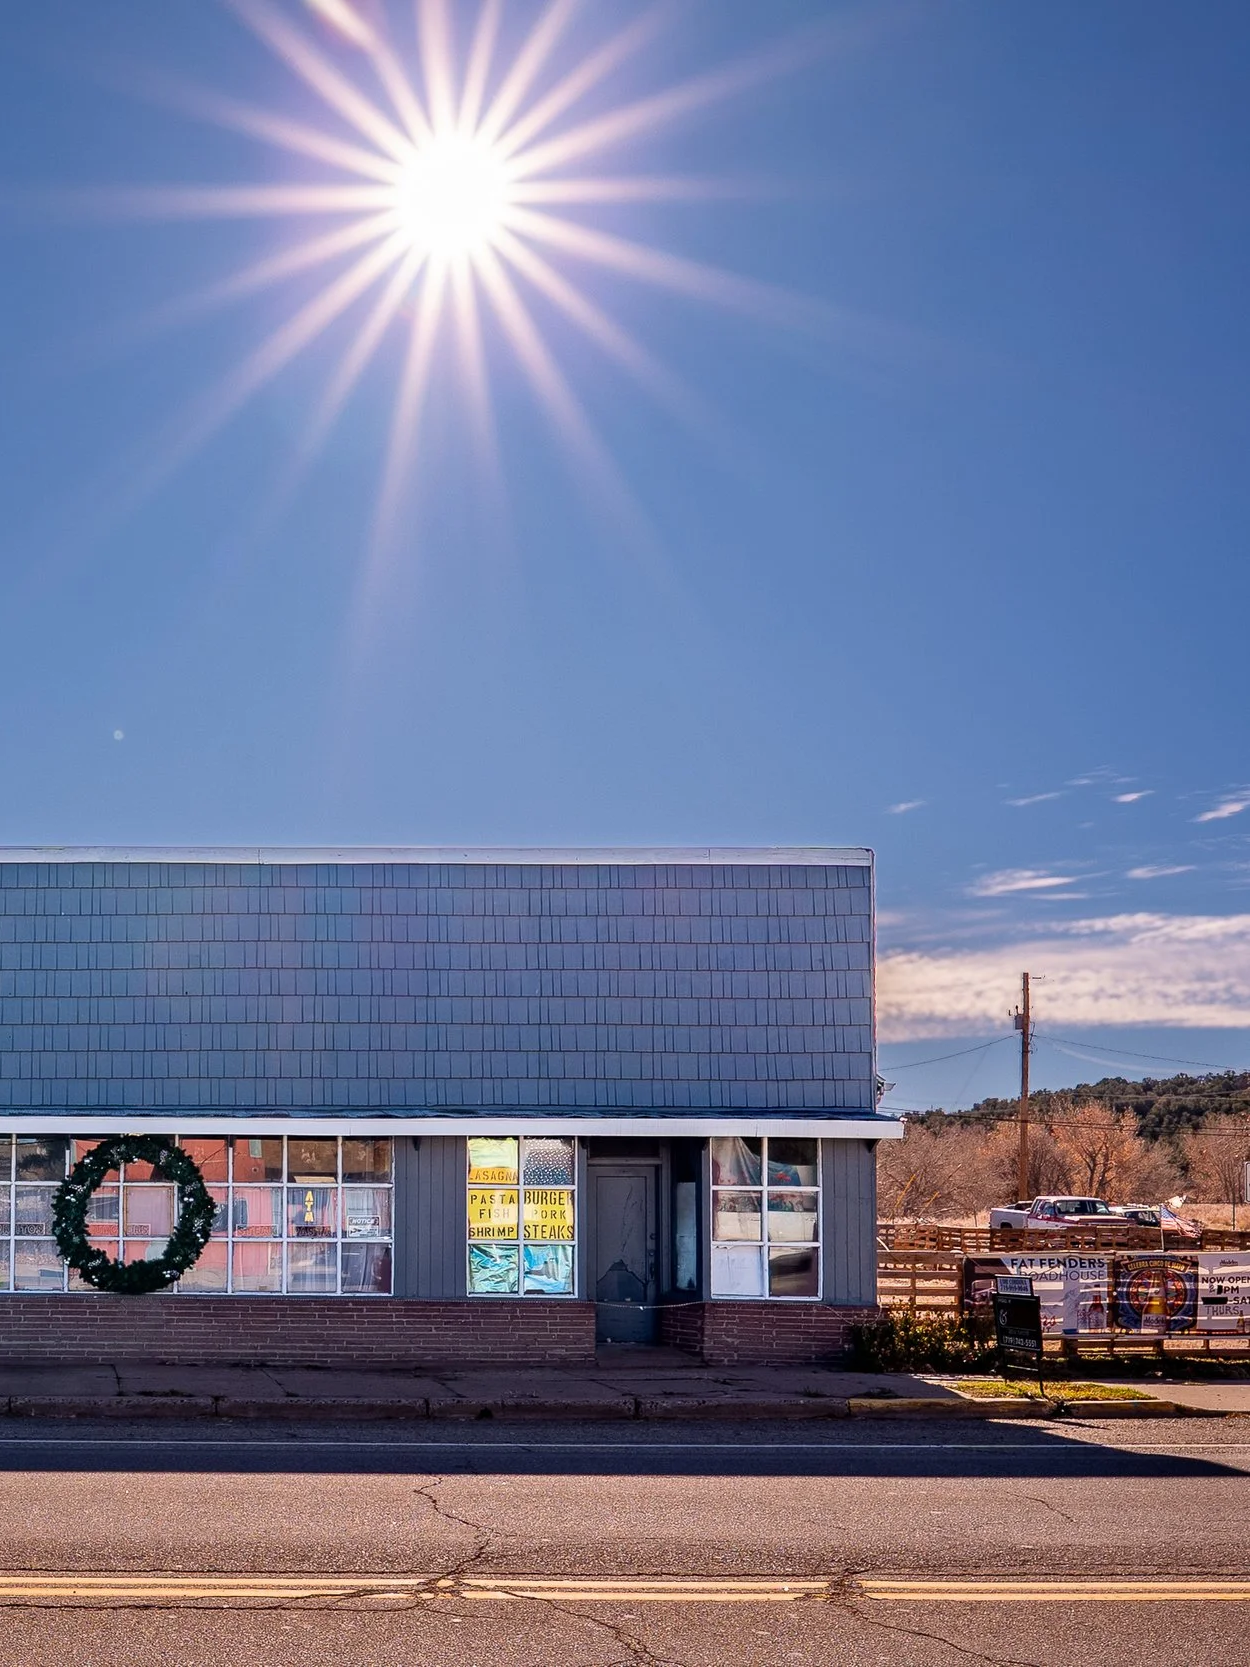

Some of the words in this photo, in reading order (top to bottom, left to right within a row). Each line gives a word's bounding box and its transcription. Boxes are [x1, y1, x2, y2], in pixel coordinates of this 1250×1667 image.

[470, 1194, 516, 1205] PASTA
[479, 1208, 510, 1219] FISH
[531, 1208, 567, 1220] PORK
[469, 1226, 515, 1238] SHRIMP
[523, 1224, 574, 1239] STEAKS
[1011, 1258, 1035, 1268] FAT
[1039, 1258, 1105, 1268] FENDERS
[1202, 1276, 1225, 1284] NOW
